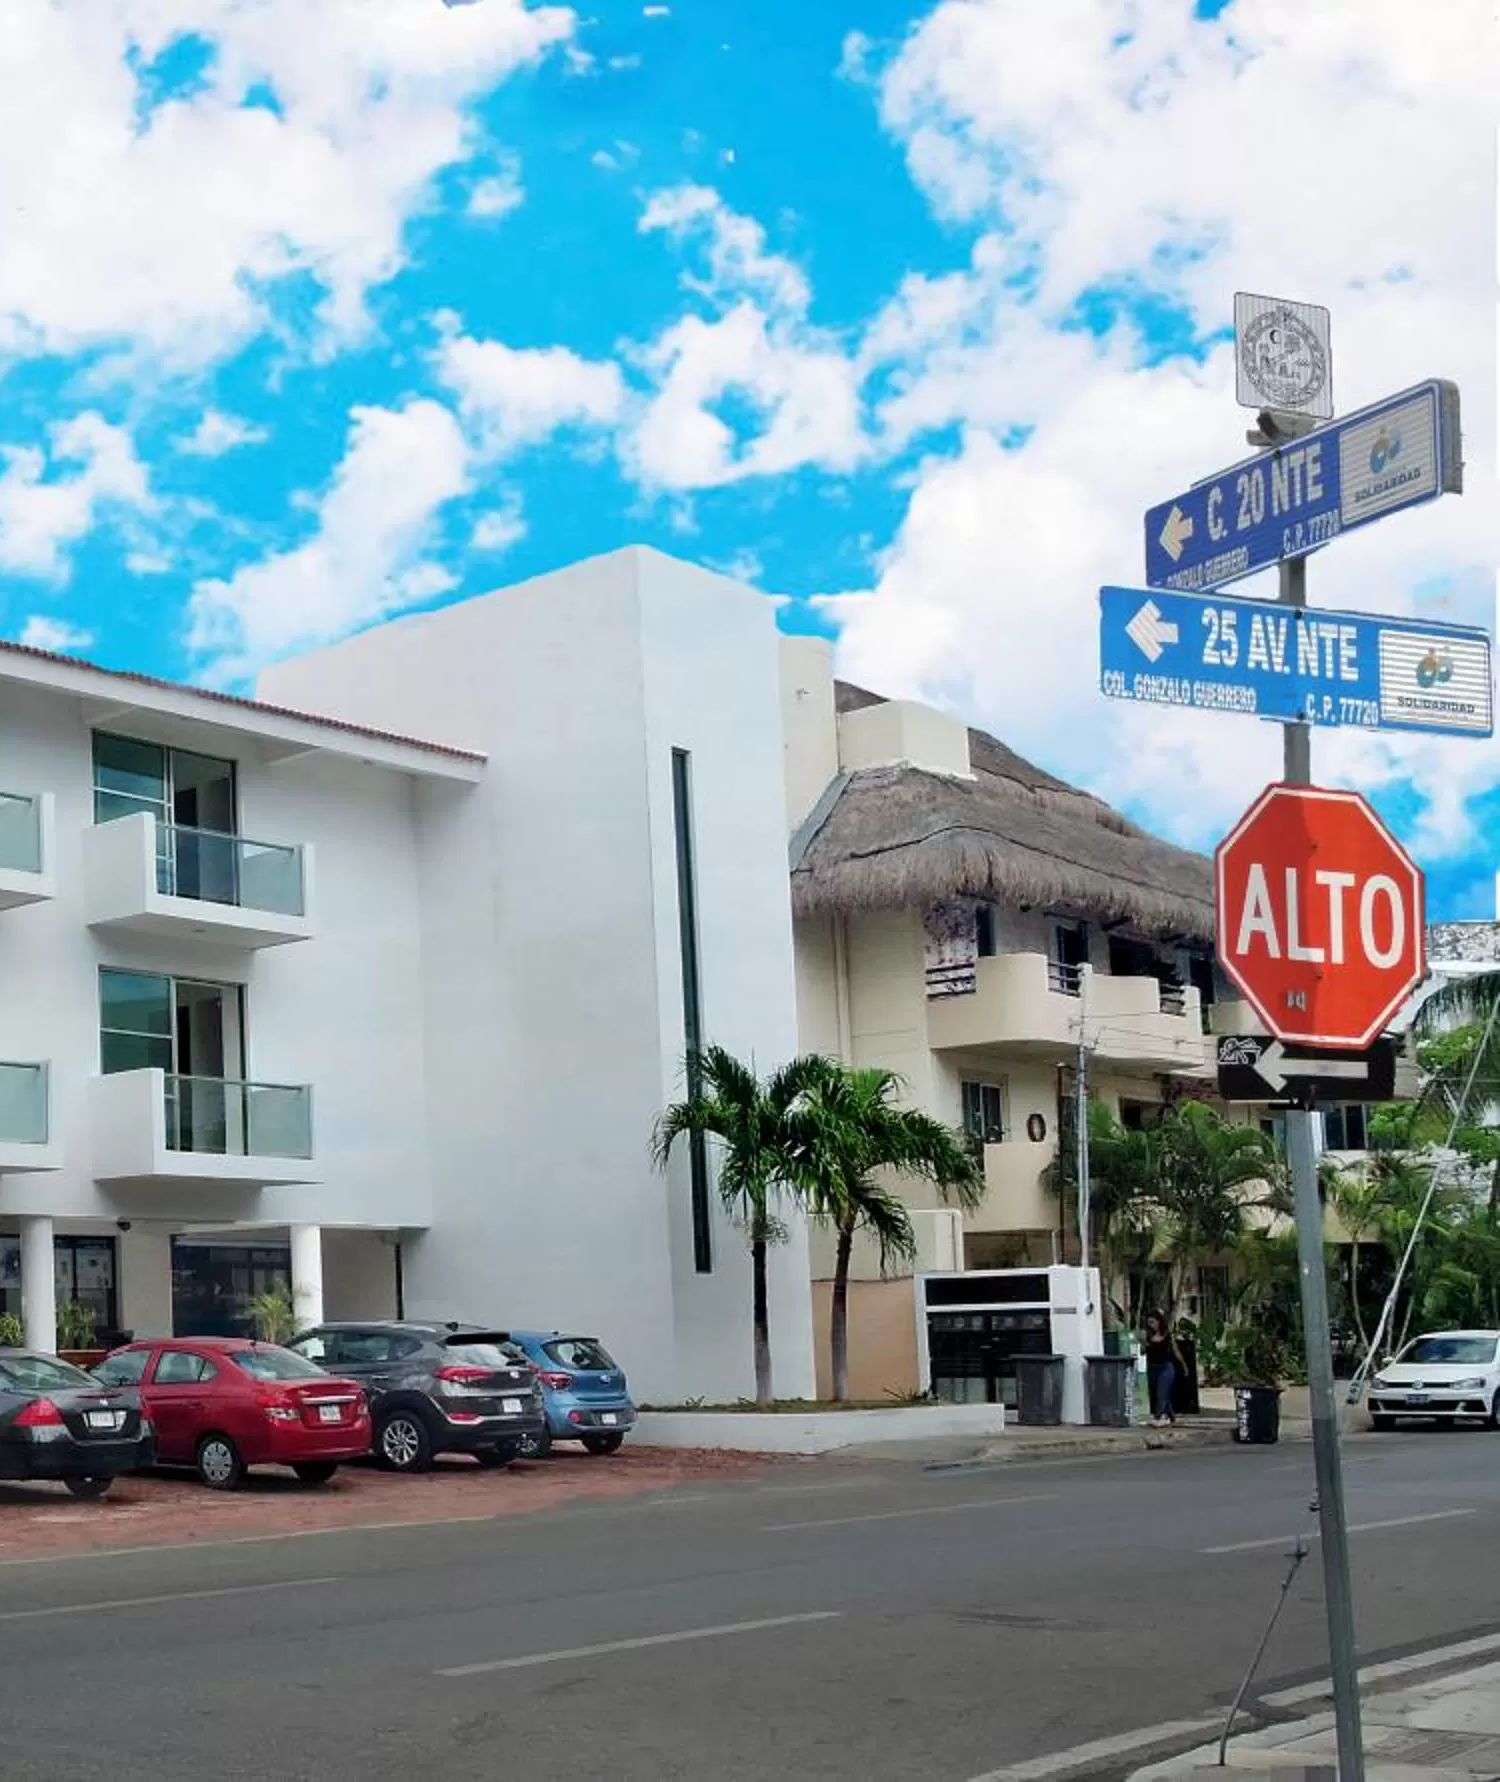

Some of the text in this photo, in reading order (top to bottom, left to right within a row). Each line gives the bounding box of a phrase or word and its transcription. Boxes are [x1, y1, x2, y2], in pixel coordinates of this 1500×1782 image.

[1207, 442, 1323, 541] C. 20 NTE
[1354, 466, 1421, 502] SOLIDARIDAD
[1202, 607, 1238, 667] 25
[1296, 619, 1359, 682] NTE
[1103, 669, 1257, 712] COL. GONZALO GUERRERO
[1338, 697, 1379, 725] 77720
[1398, 695, 1476, 714] SOLIDARIDAD
[1236, 863, 1405, 969] ALTO
